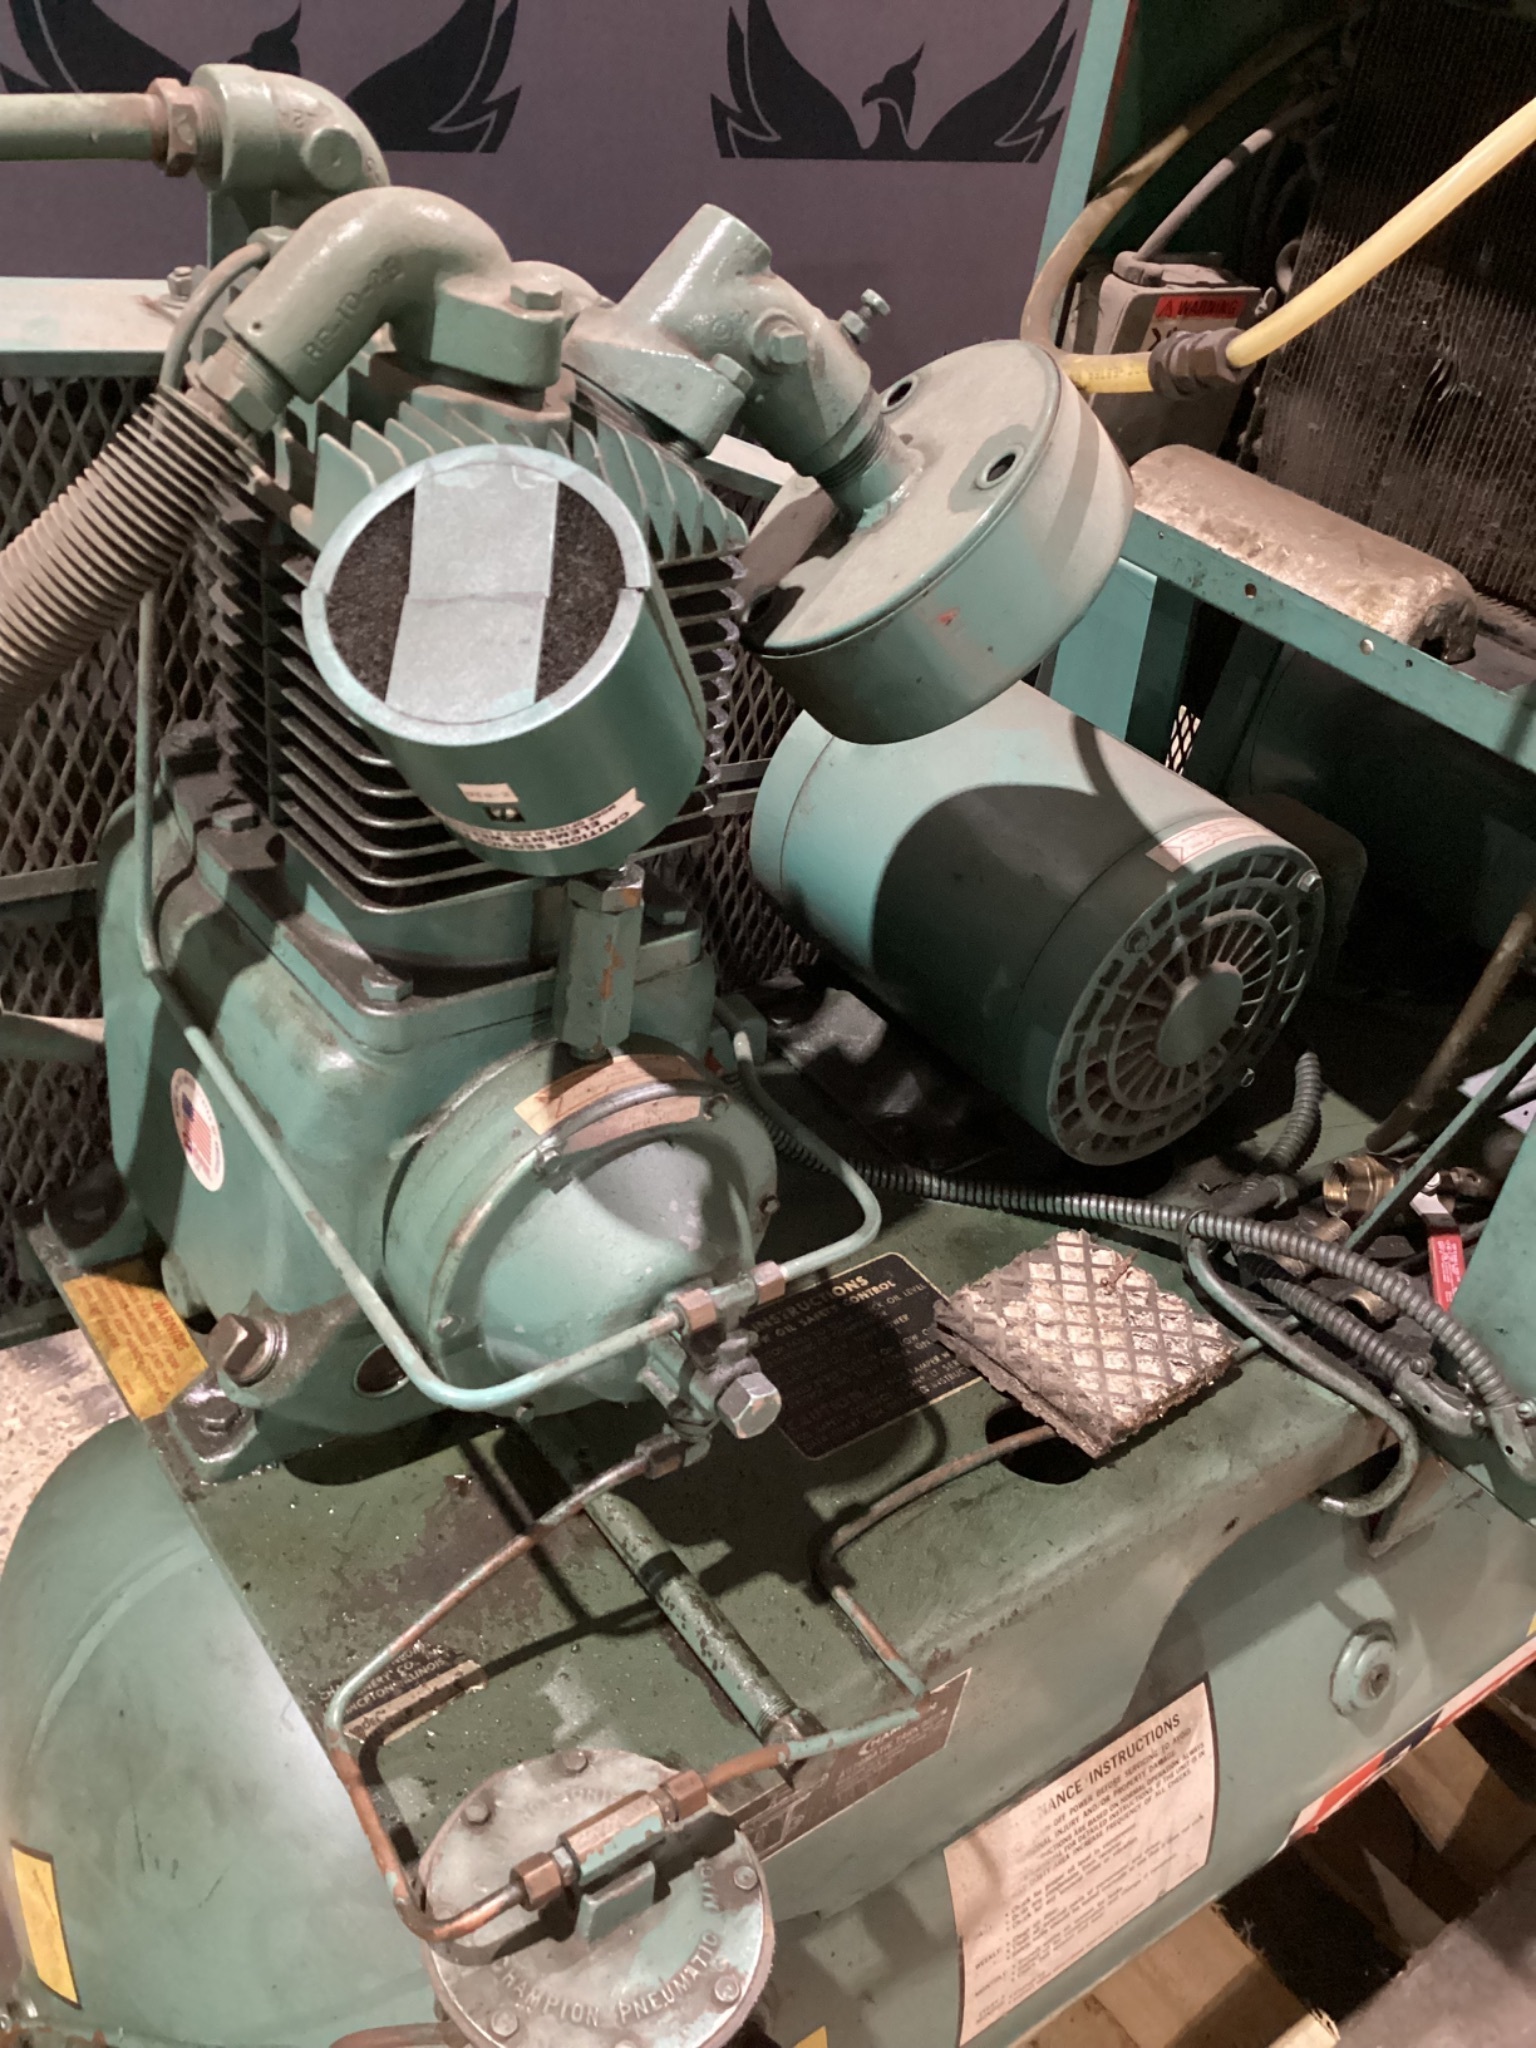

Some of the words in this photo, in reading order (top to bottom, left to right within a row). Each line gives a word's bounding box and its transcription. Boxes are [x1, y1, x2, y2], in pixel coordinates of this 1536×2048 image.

[1177, 299, 1239, 316] WARNING
[843, 1279, 896, 1305] CONTROL
[1089, 1712, 1180, 1785] INSTRUCTIONS
[491, 1955, 600, 2027] CHAMPION
[617, 1929, 722, 2024] PNEUMATIC
